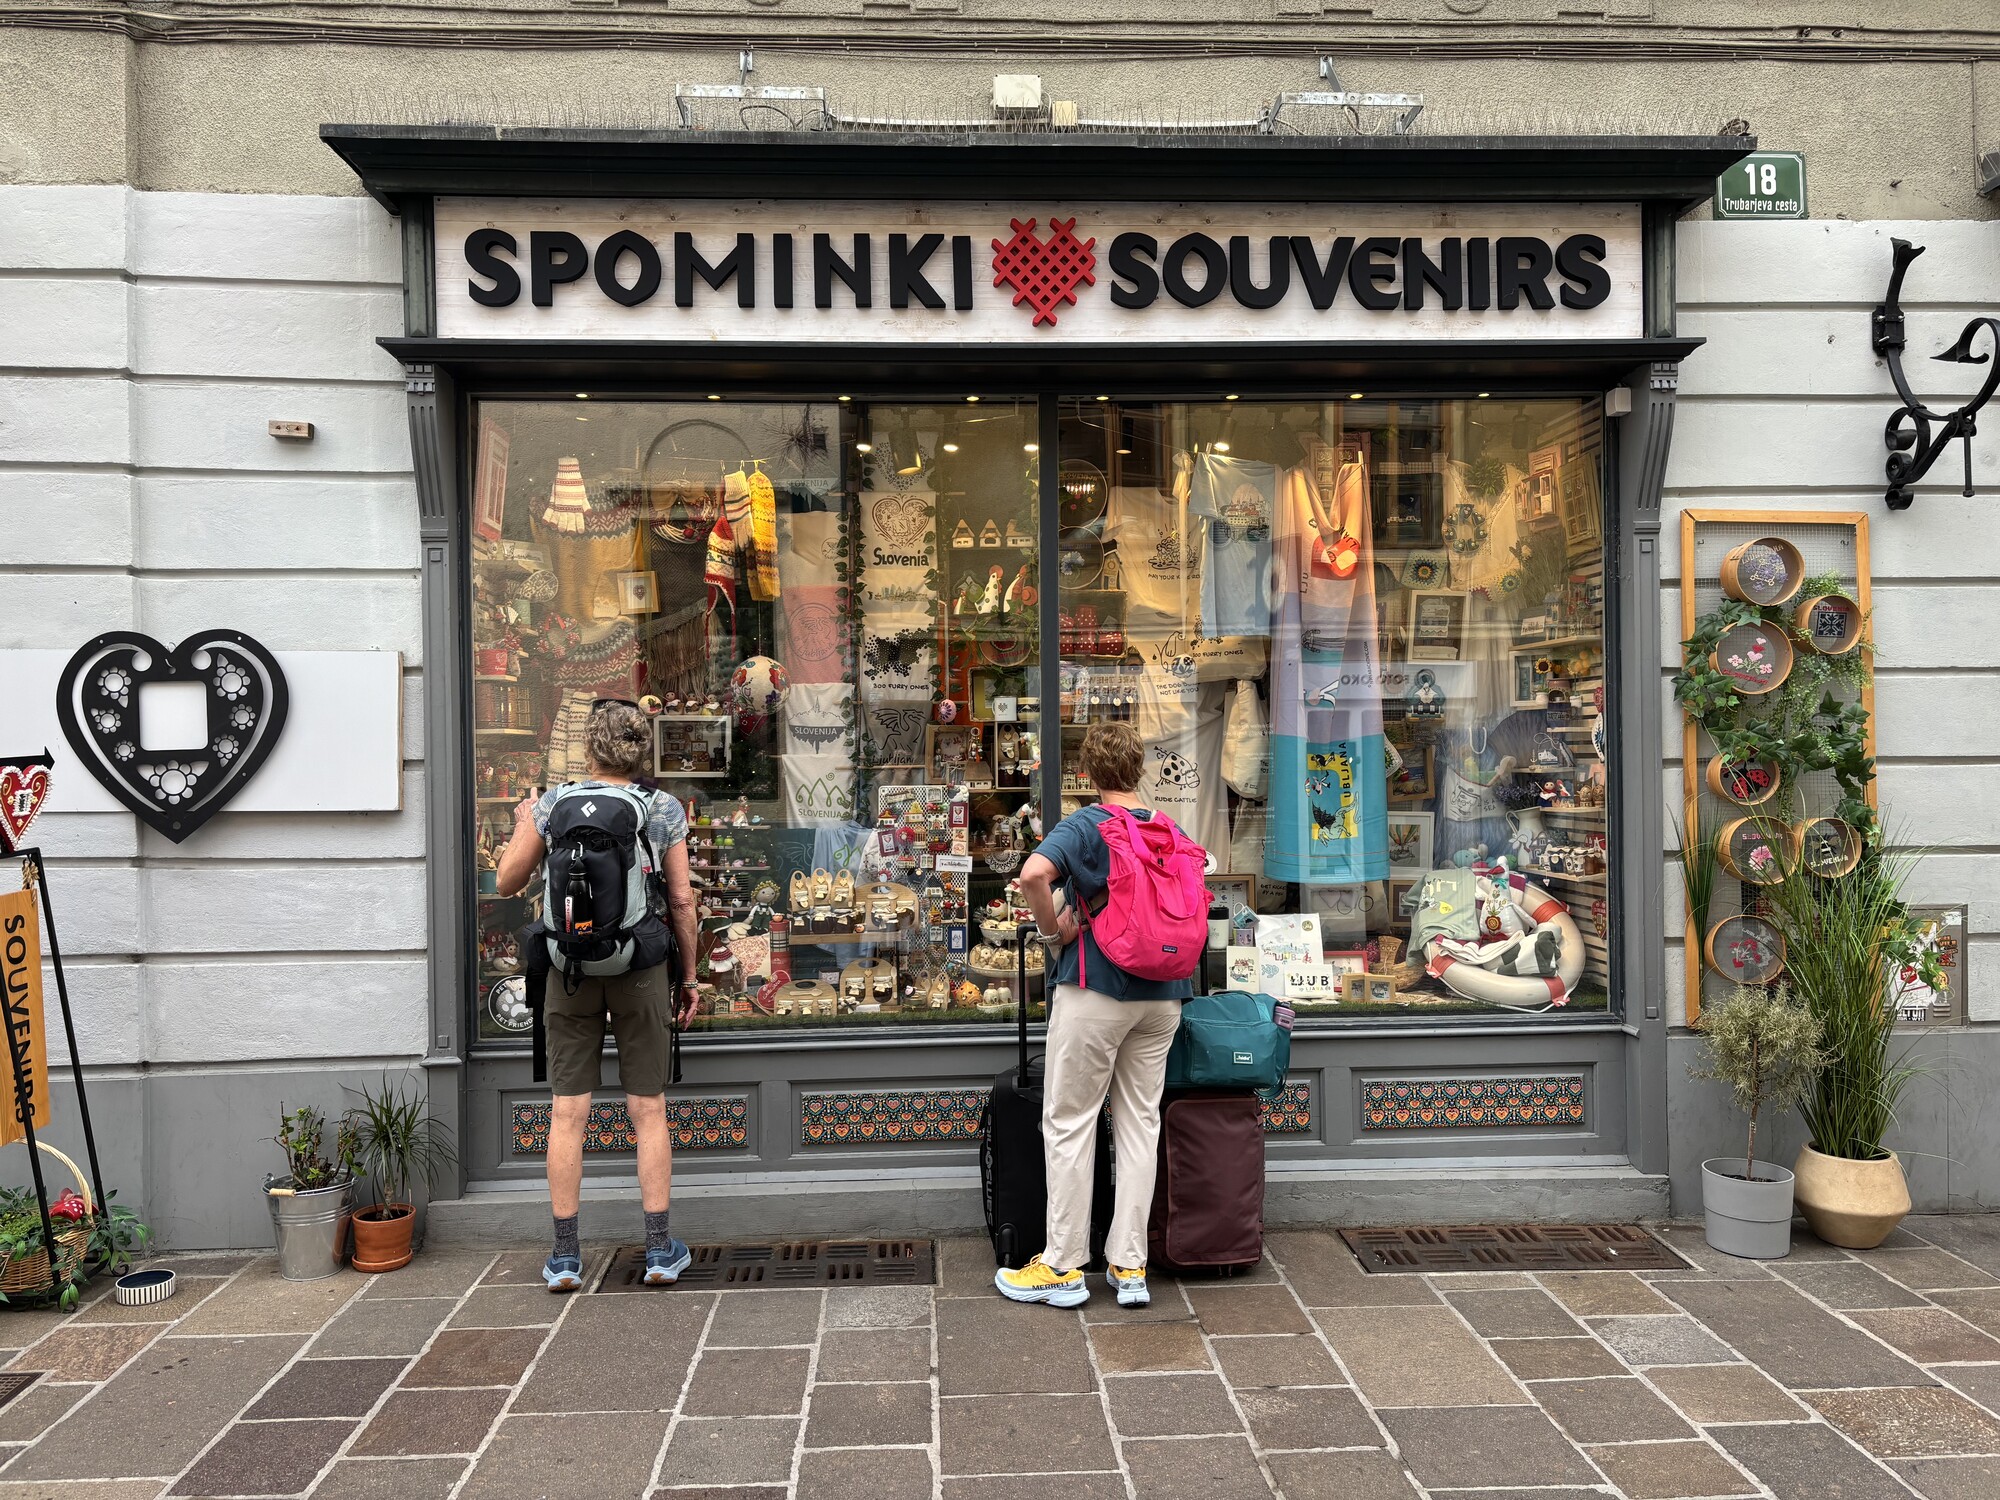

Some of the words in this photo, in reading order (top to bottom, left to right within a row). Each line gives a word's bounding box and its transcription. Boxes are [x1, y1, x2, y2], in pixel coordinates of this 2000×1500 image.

[1744, 163, 1777, 195] 18
[1724, 197, 1773, 213] Trubarjeva
[1775, 198, 1798, 212] cesta
[464, 228, 974, 310] SPOMINKI
[1109, 232, 1611, 311] SOUVENIRS
[794, 726, 838, 736] SLOVENIJA
[872, 754, 915, 766] Ljubljan
[798, 808, 842, 819] SLOVENIJA
[496, 983, 507, 995] PET
[496, 1013, 507, 1025] PET
[1032, 1280, 1071, 1291] MERRELL
